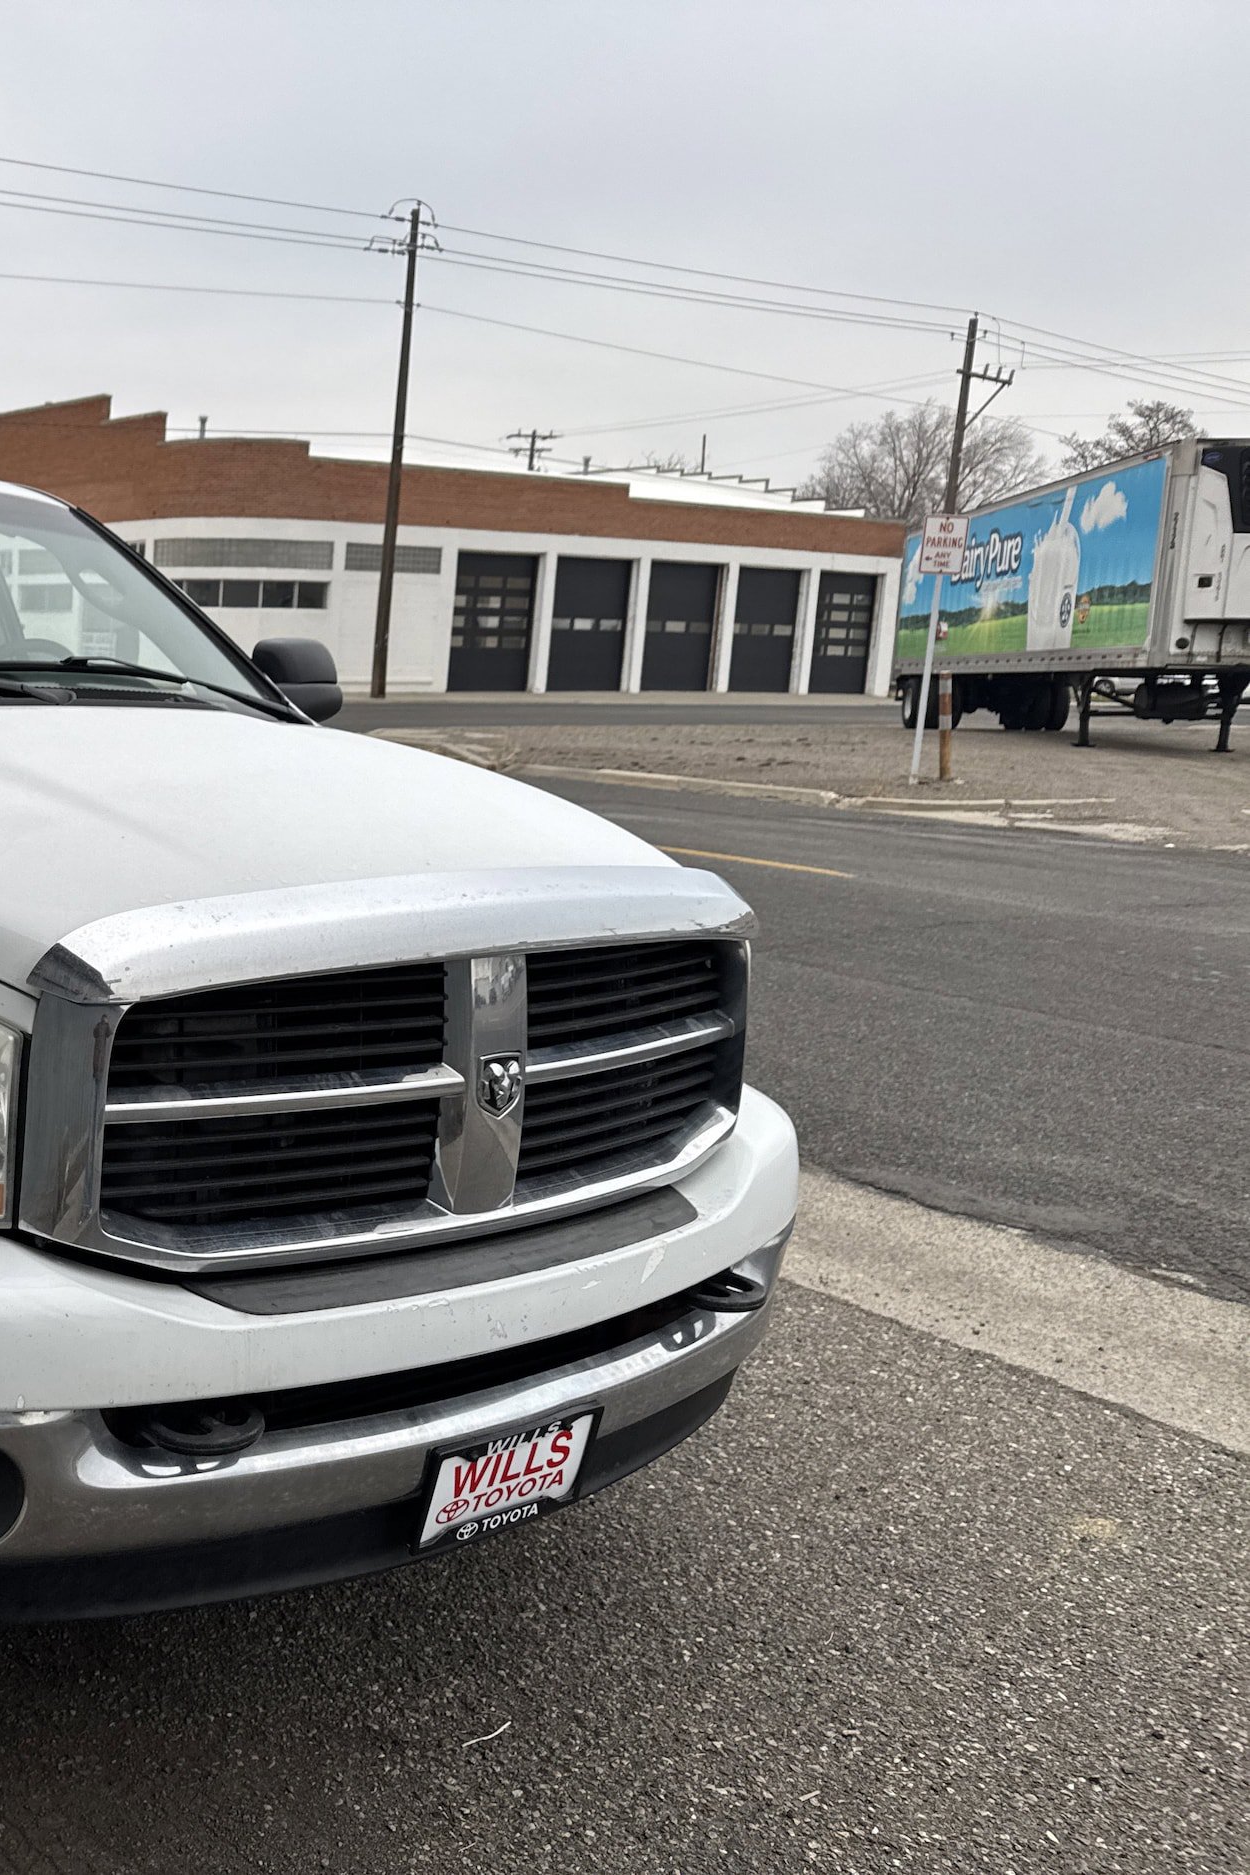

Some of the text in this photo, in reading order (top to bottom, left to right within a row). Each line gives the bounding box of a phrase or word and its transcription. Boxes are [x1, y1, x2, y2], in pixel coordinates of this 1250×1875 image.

[926, 536, 963, 548] PARKING
[939, 522, 954, 533] NO
[934, 551, 952, 559] ANY
[951, 530, 1022, 590] airyPure
[487, 1420, 562, 1455] WILLS
[453, 1429, 573, 1499] WILLS
[473, 1469, 563, 1512] TOYOTA
[481, 1502, 539, 1532] TOYOTA
